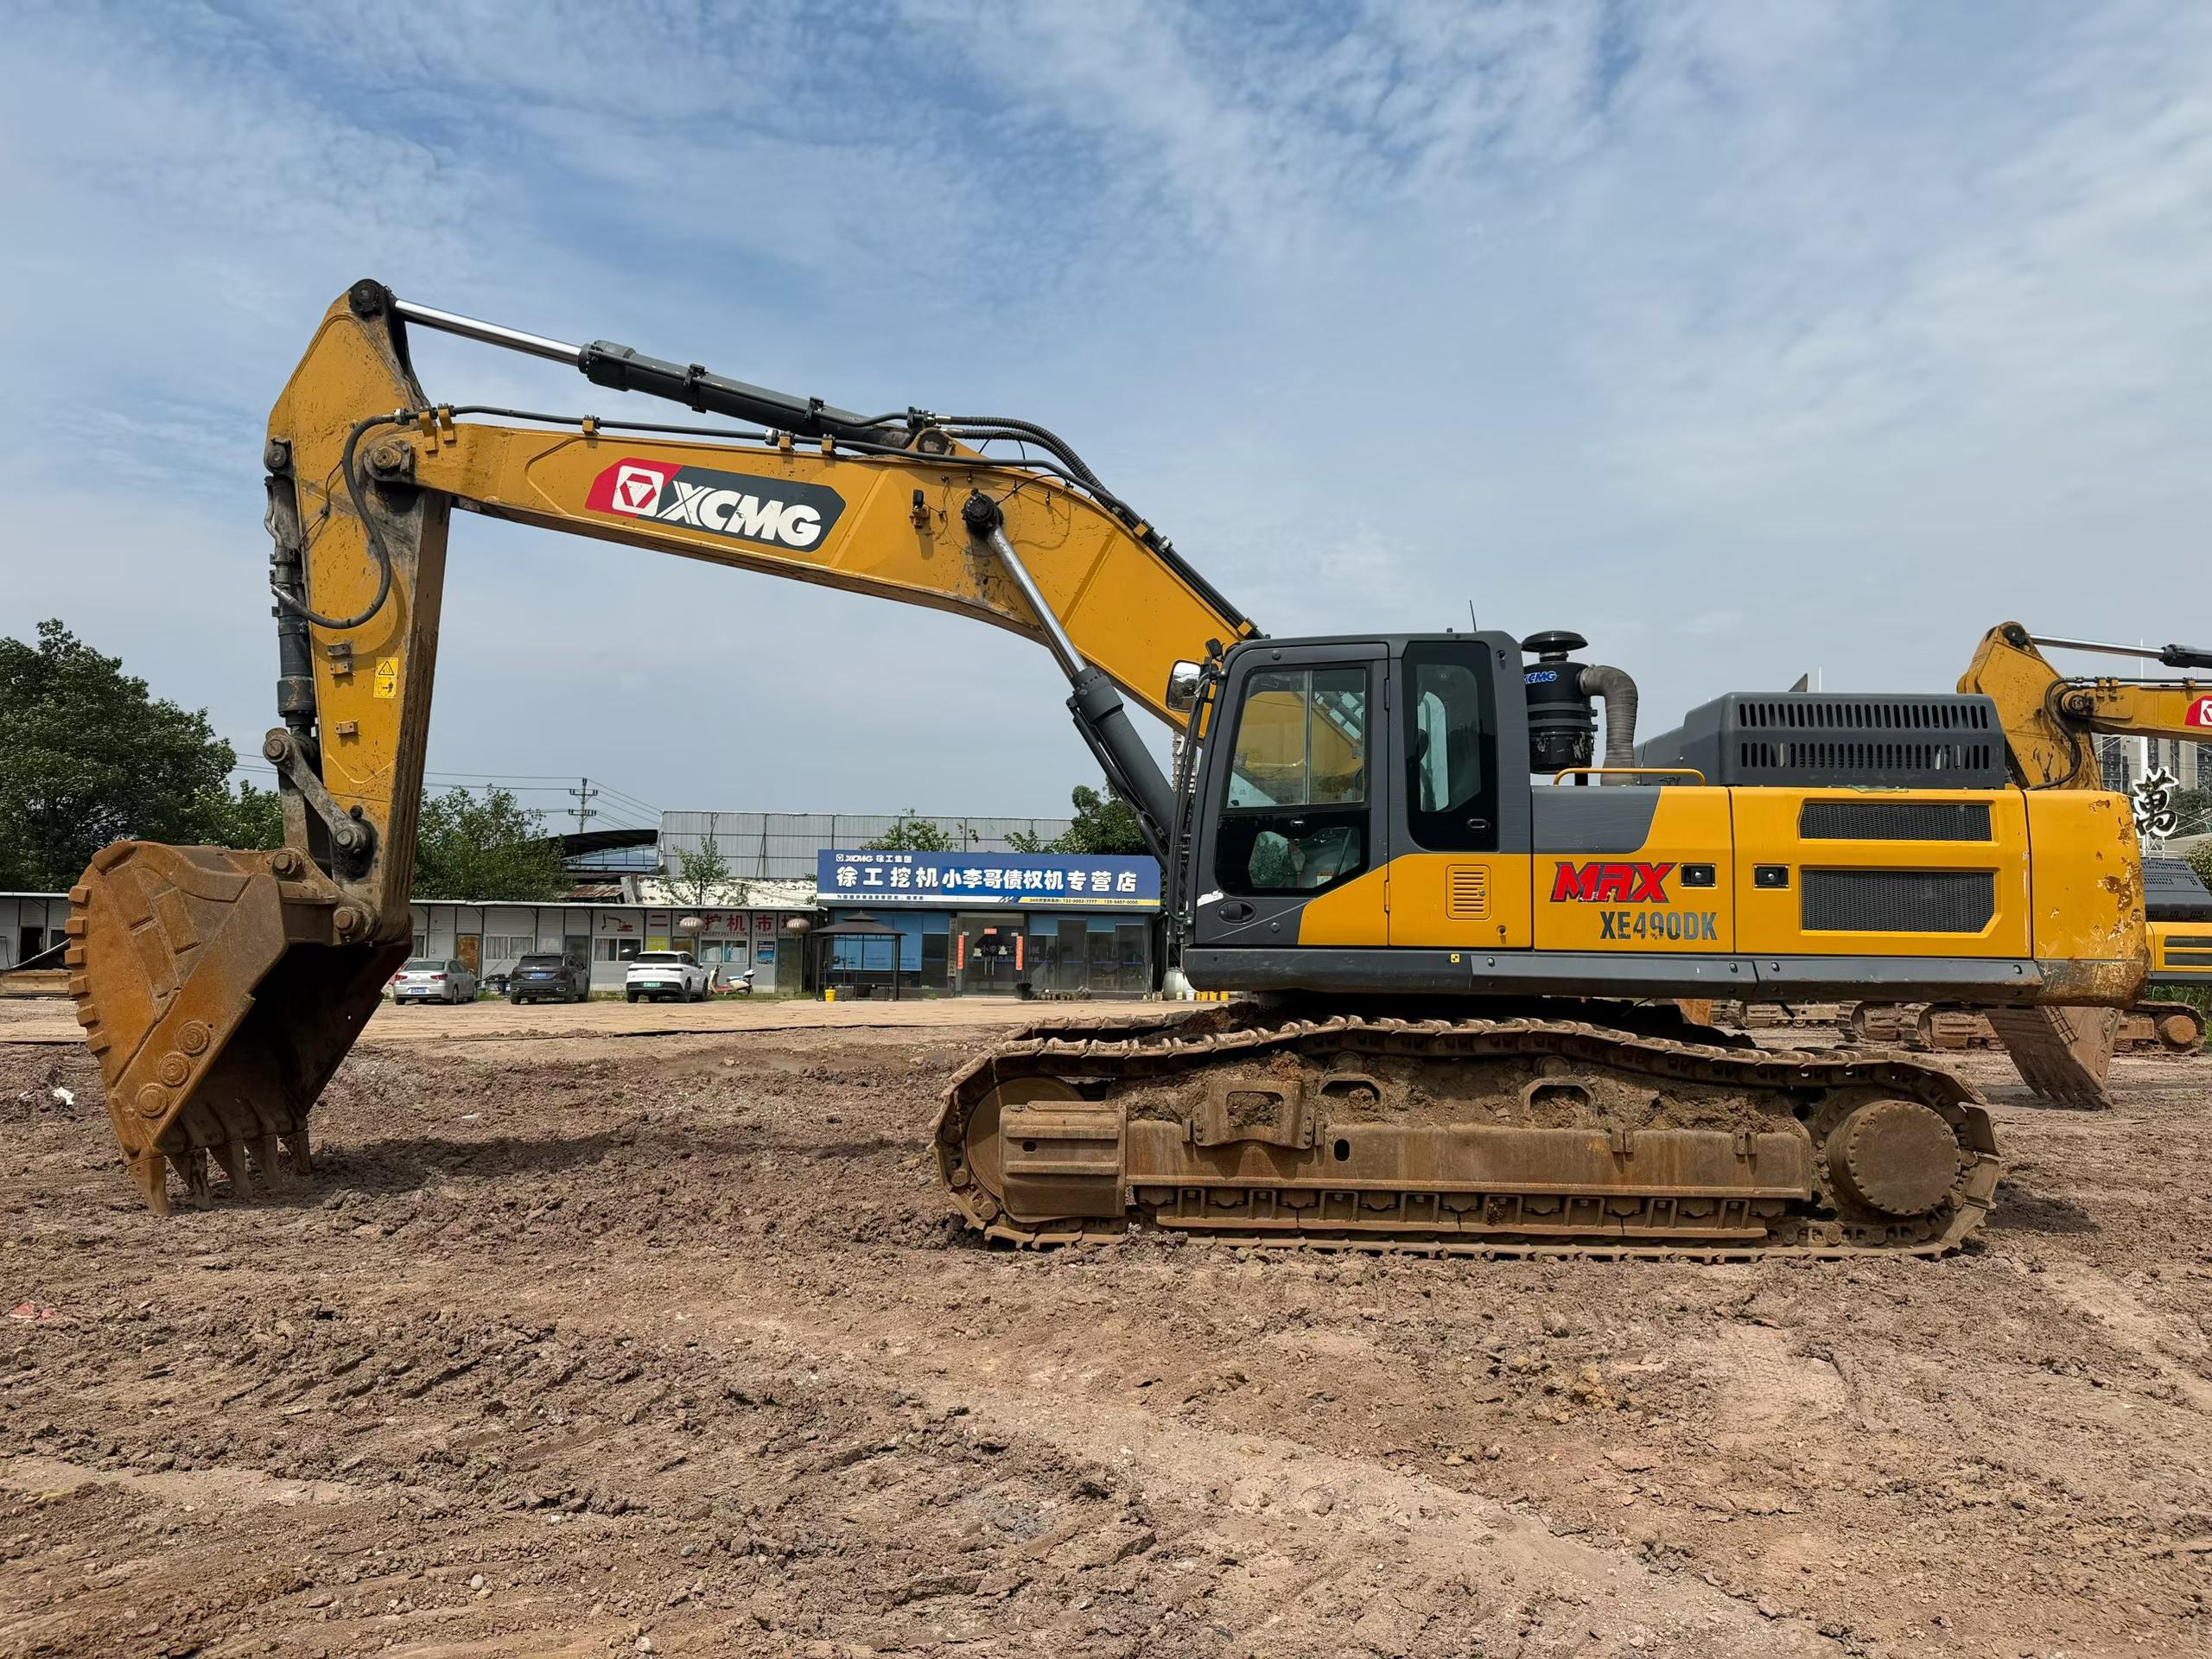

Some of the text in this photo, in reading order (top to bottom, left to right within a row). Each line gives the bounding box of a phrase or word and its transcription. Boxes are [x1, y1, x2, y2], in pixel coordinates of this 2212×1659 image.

[655, 480, 822, 547] XCMG
[1524, 671, 1558, 684] CMG
[1549, 861, 1677, 903] MAX
[1599, 911, 1718, 941] XE490DK
